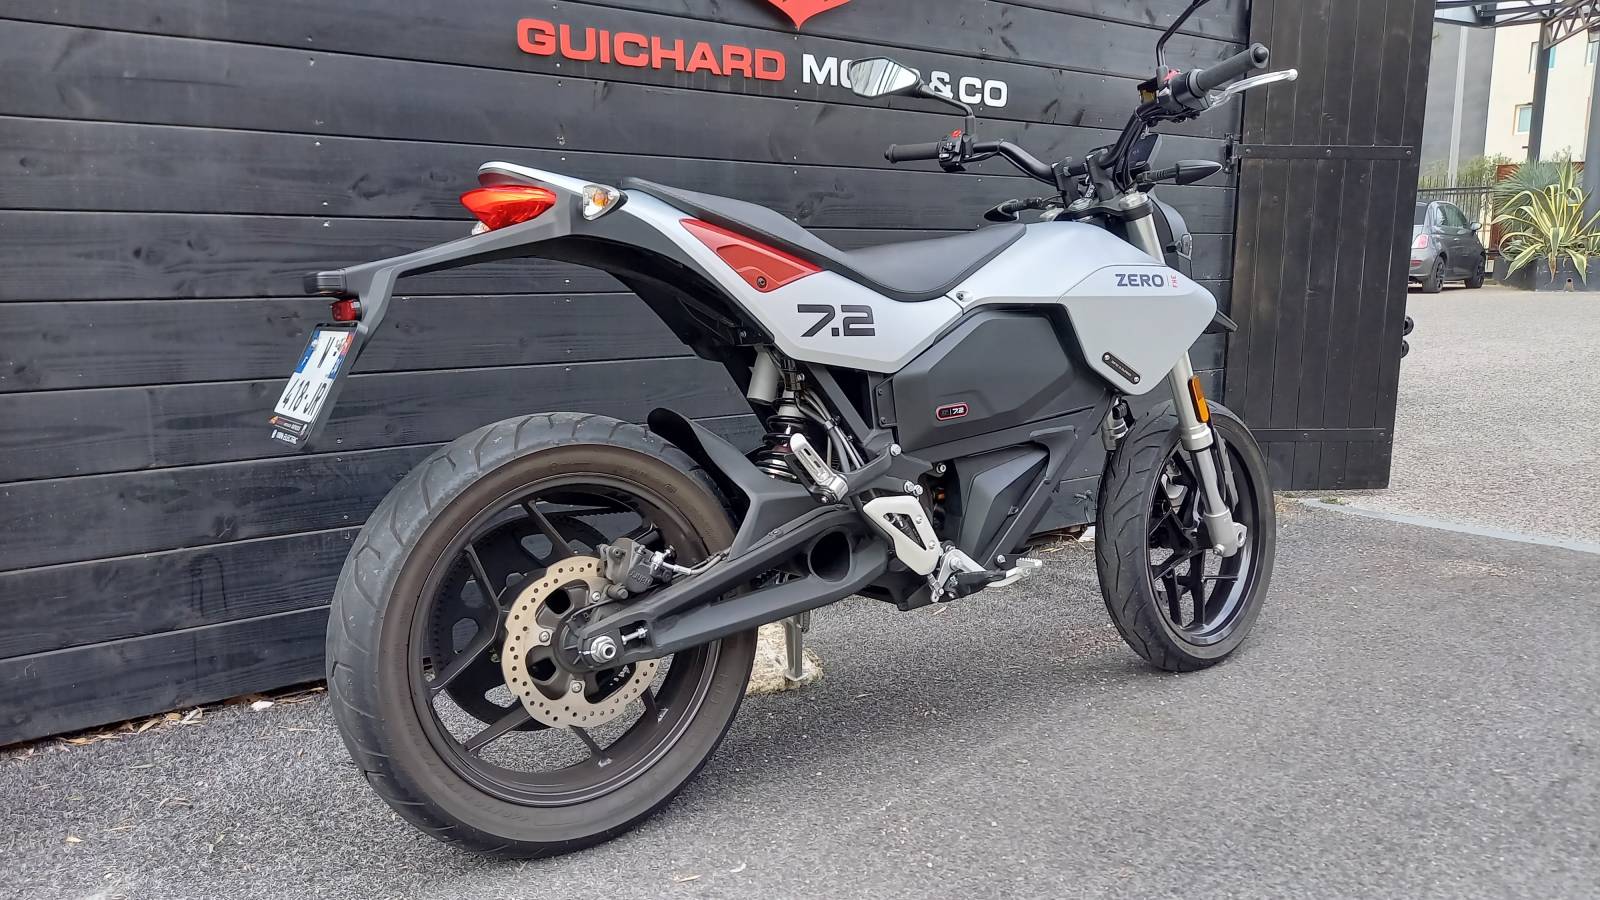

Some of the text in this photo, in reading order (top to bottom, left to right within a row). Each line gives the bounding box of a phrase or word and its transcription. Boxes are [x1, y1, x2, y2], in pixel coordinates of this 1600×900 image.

[517, 18, 786, 81] GUICHARD
[1115, 273, 1165, 287] ZERO
[797, 304, 876, 337] 7.2
